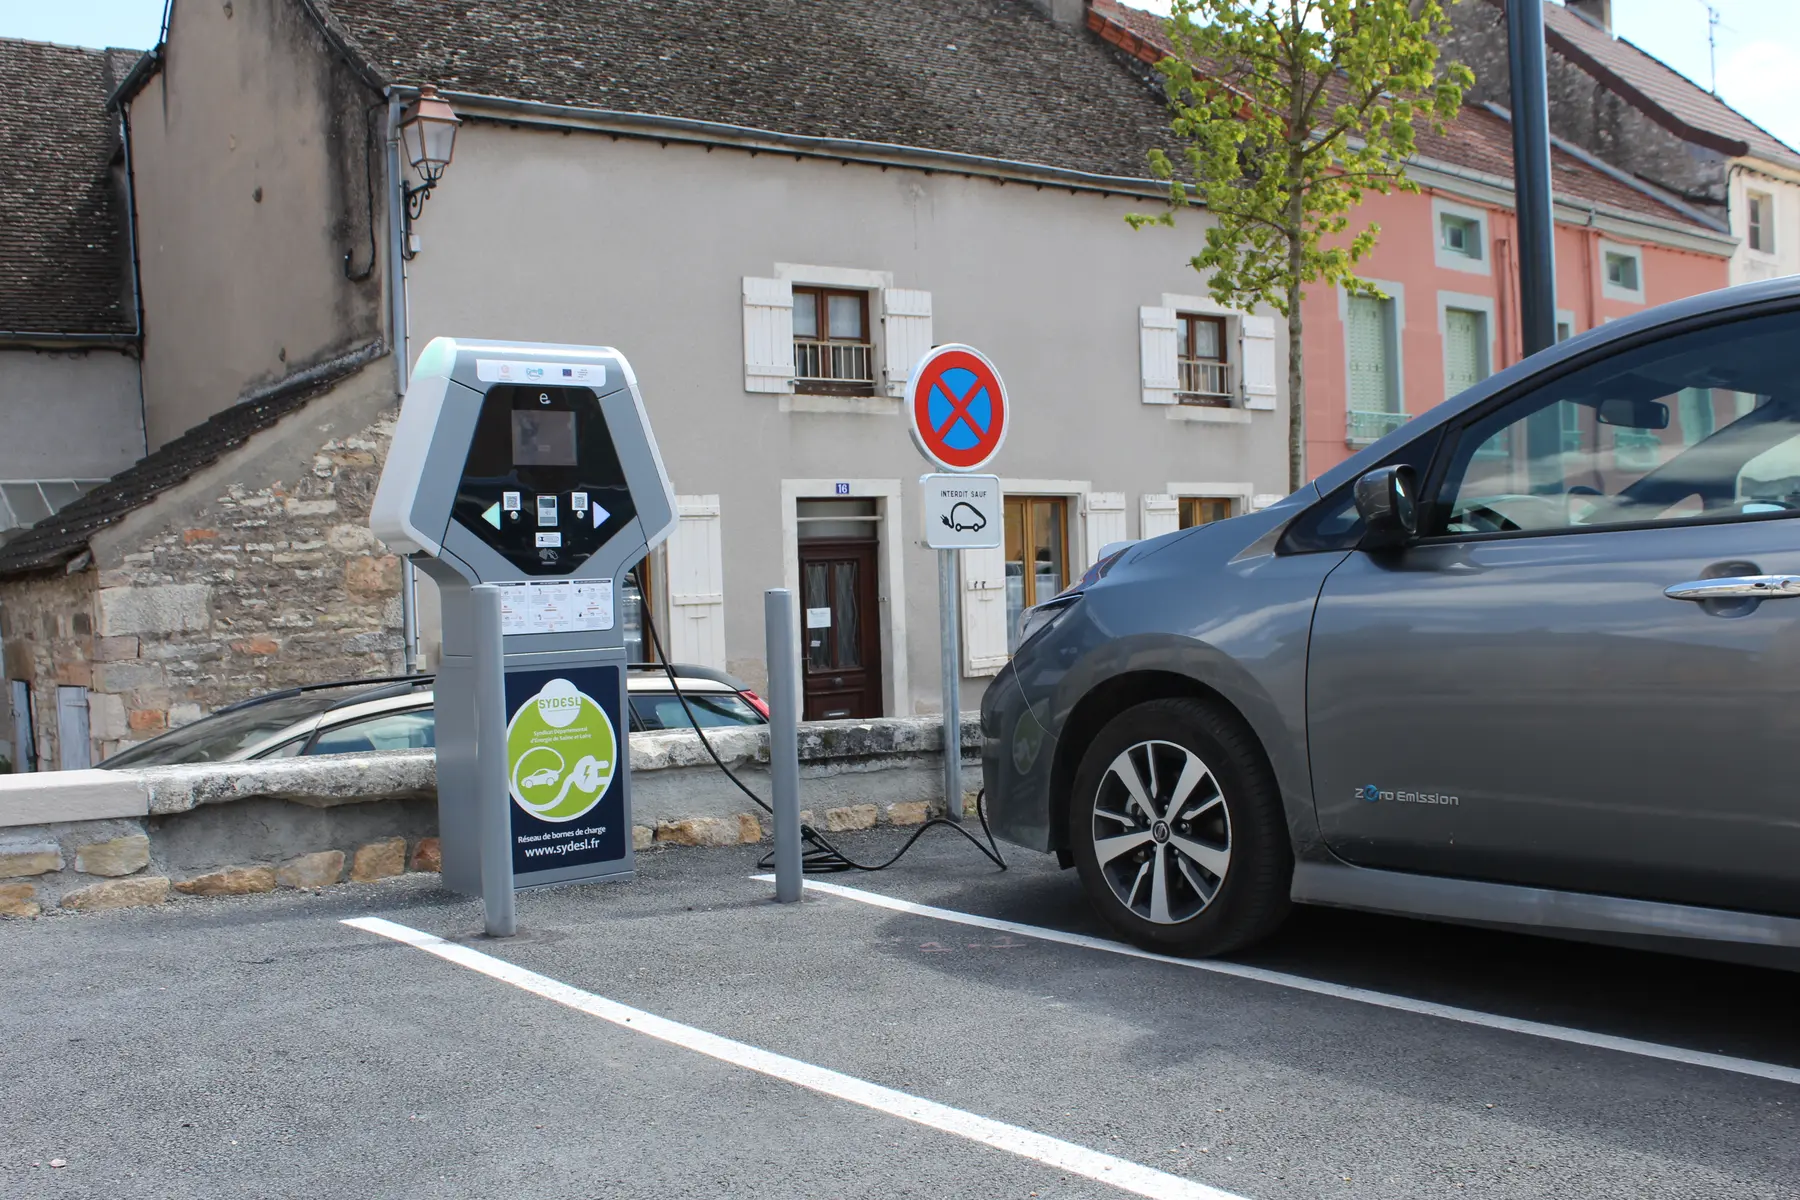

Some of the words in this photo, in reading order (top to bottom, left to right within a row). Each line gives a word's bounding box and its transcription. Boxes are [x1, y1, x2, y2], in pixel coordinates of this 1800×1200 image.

[838, 484, 847, 494] 16
[940, 490, 968, 498] INTERDIT
[970, 490, 987, 498] SAUF
[538, 697, 581, 709] SYDESL
[1396, 791, 1460, 806] Emission
[518, 834, 542, 844] Réseau
[542, 832, 551, 840] de
[551, 831, 574, 839] bornes
[575, 828, 583, 836] de
[584, 826, 606, 835] charge
[525, 838, 600, 857] www.sydesl.fr
